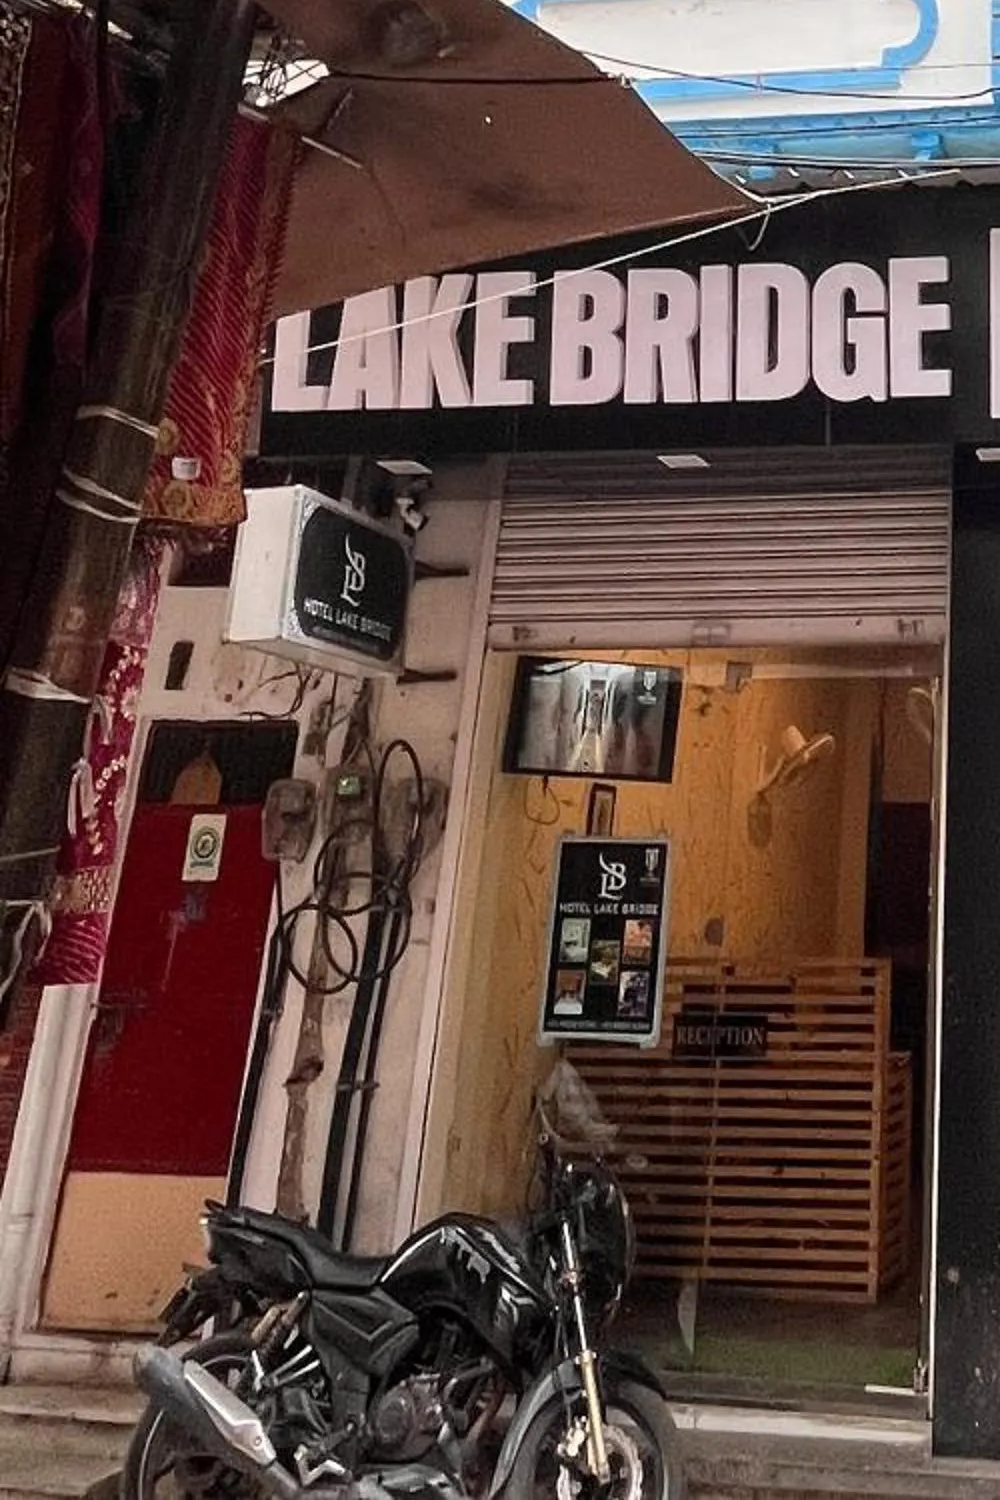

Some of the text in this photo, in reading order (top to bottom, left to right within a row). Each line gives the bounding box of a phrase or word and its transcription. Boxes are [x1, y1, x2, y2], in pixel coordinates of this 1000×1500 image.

[271, 270, 536, 412] LAKE
[549, 255, 953, 405] BRIDGE
[303, 596, 333, 622] HOTEL
[335, 607, 359, 630] LAKE
[560, 902, 592, 913] HOTEL
[593, 903, 619, 915] LAKE
